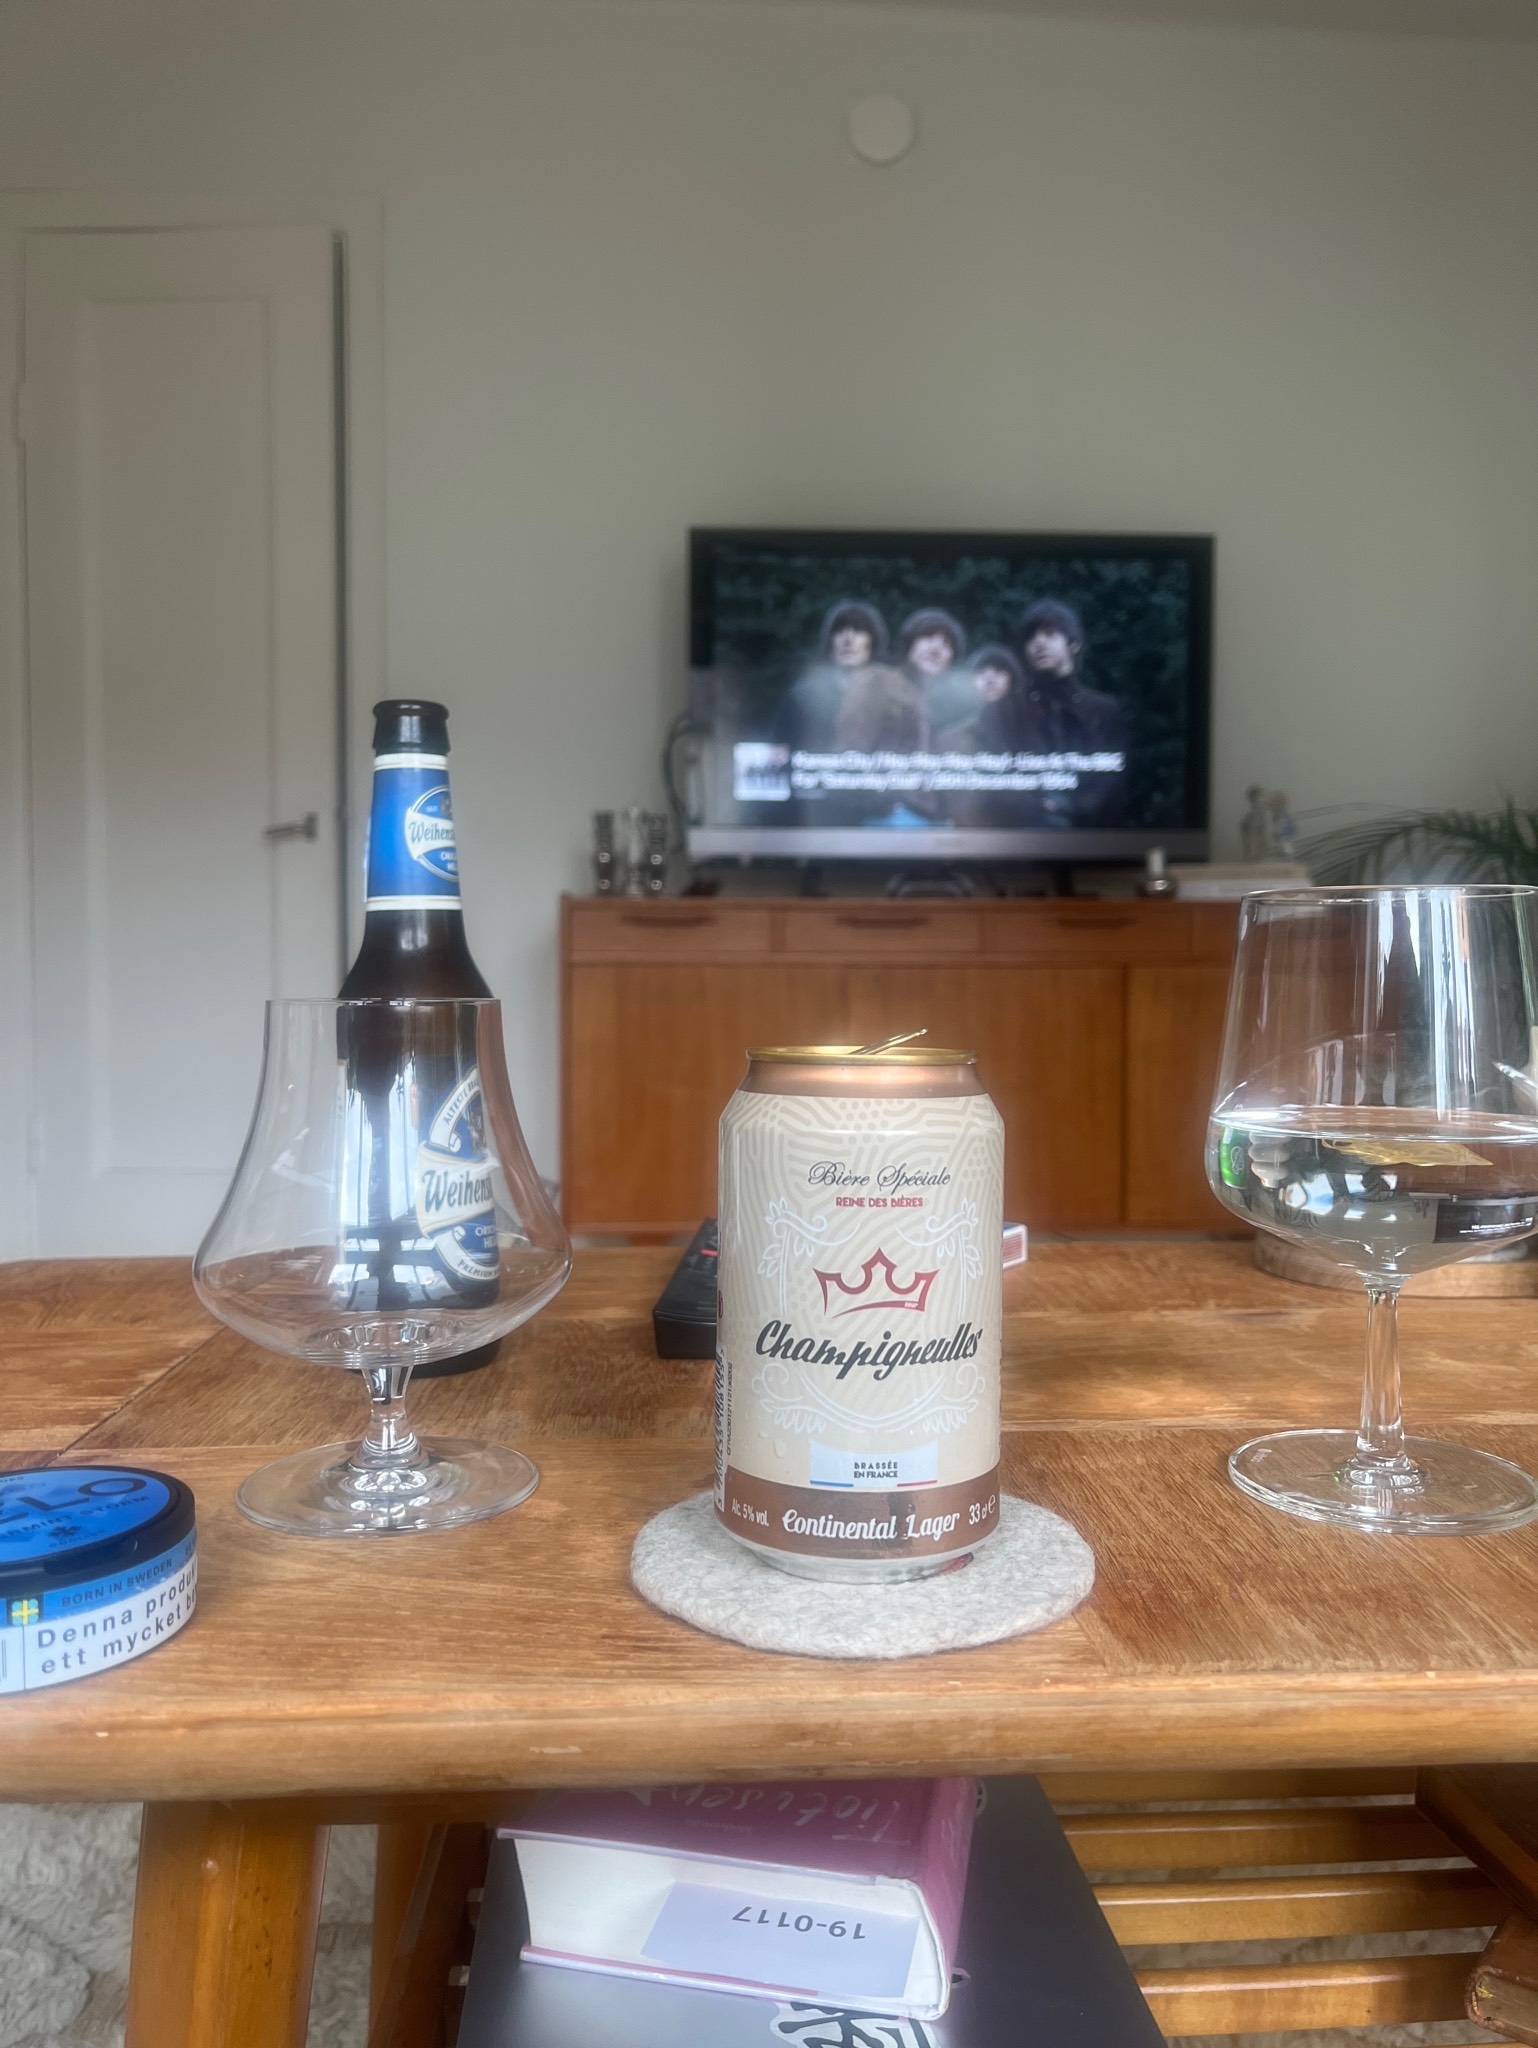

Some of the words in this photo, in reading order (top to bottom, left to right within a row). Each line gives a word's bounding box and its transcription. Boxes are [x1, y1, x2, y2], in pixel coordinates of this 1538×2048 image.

[808, 1161, 870, 1186] Bière
[877, 1162, 951, 1195] Spéciale
[836, 1197, 865, 1207] REINE
[868, 1197, 887, 1207] DES
[891, 1195, 923, 1208] BIÈRES
[755, 1319, 984, 1381] Champigneulles
[853, 1461, 898, 1470] BRASSÉE
[853, 1471, 865, 1479] EN
[867, 1471, 898, 1479] FRANCE
[756, 1510, 770, 1527] vol.
[782, 1509, 897, 1540] Continental
[903, 1511, 961, 1542] Lager
[62, 1587, 104, 1608] BORN
[109, 1581, 123, 1594] IN
[127, 1557, 172, 1588] SWEDEN
[38, 1609, 133, 1649] Denna
[146, 1562, 196, 1618] produk
[41, 1647, 87, 1674] ett
[103, 1602, 181, 1658] mycket
[731, 1905, 866, 1940] 19-0117
